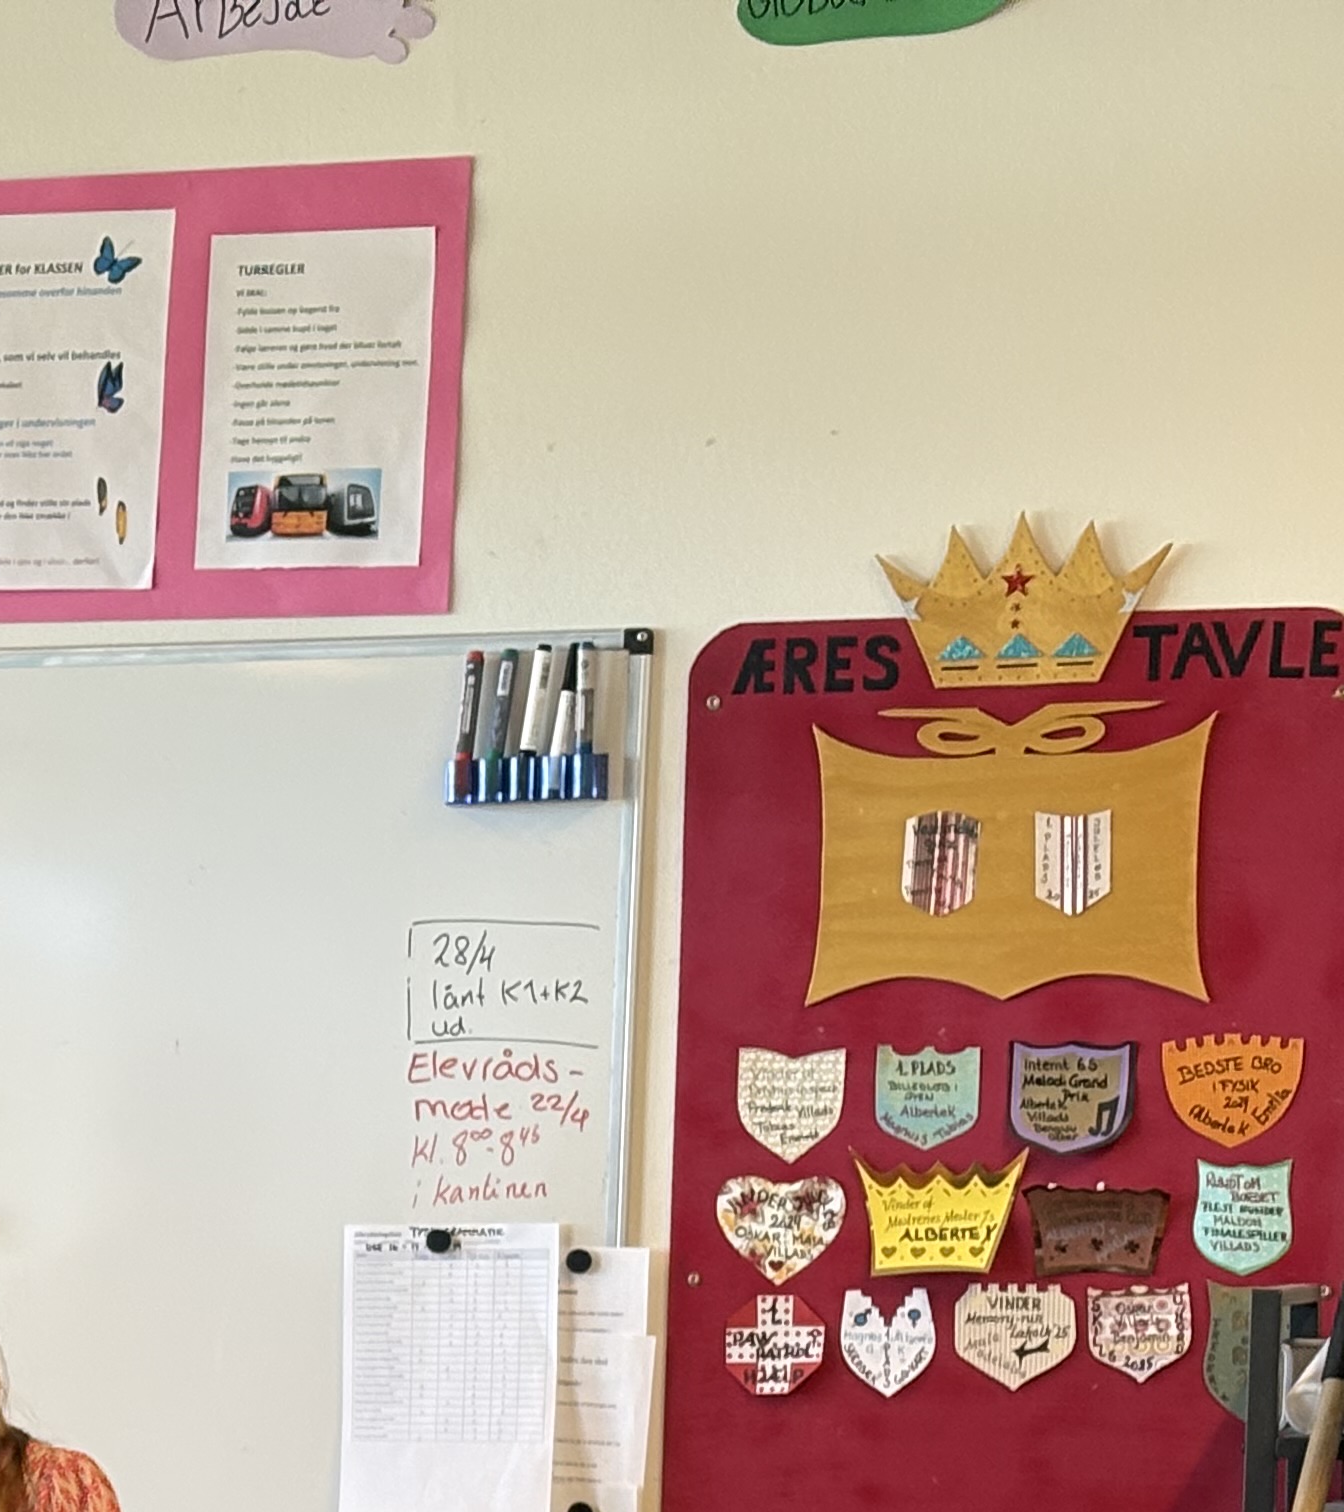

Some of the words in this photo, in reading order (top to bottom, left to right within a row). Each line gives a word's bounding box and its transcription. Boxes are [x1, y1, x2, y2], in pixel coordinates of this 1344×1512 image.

[14, 263, 31, 275] for
[34, 262, 83, 275] KLASSEN
[732, 636, 902, 696] ÆRES
[1133, 620, 1342, 682] TAVLE
[433, 929, 496, 975] 28/4
[501, 978, 589, 1006] K1+K2
[911, 1060, 957, 1077] PLADS
[1177, 1055, 1243, 1086] BEDSTE
[1250, 1055, 1282, 1075] BRO
[1068, 1073, 1108, 1089] Grand
[530, 1089, 590, 1132] 22/4
[432, 1172, 548, 1207] kantinen
[881, 1198, 920, 1212] Vinder
[898, 1226, 981, 1242] ALBERTE
[986, 1295, 1043, 1312] VINDER
